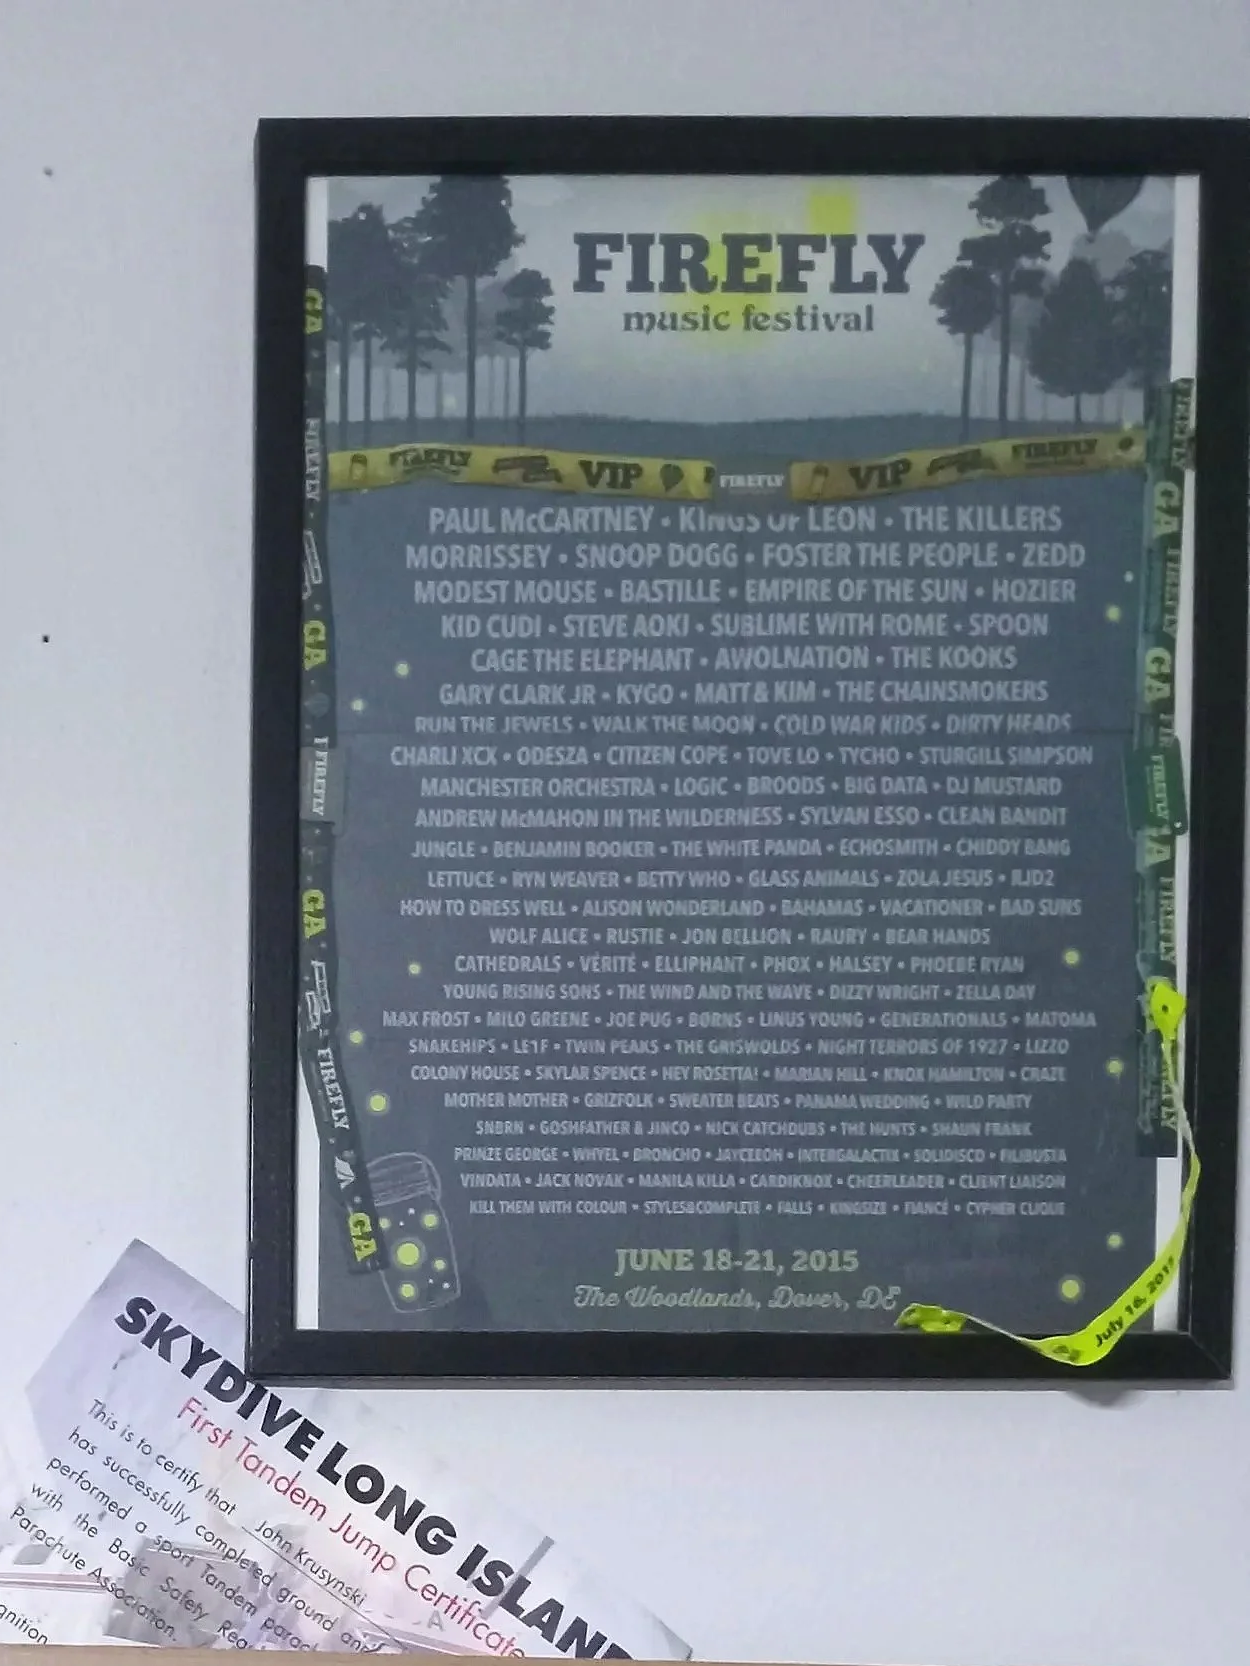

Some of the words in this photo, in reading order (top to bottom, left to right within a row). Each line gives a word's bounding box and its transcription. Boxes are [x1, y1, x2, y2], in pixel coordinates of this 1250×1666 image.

[572, 232, 926, 294] FIREFLY
[622, 305, 731, 334] music
[741, 304, 874, 332] festival
[1011, 438, 1098, 460] FIREFLY
[578, 459, 644, 490] VIP
[849, 458, 911, 491] VIP
[429, 506, 498, 533] PAUL
[501, 506, 654, 533] McCARTNEY
[807, 506, 876, 532] LEON
[900, 506, 950, 532] THE
[956, 505, 1063, 532] KILLERS
[1154, 480, 1180, 539] GA
[405, 543, 551, 569] MORRISSEY
[575, 543, 662, 569] SNOOP
[668, 543, 738, 568] DOGG
[762, 542, 851, 568] FOSTER
[856, 542, 901, 568] THE
[907, 542, 998, 568] PEOPLE
[1021, 542, 1086, 568] ZEDD
[414, 580, 509, 604] MODEST
[514, 580, 597, 604] MOUSE
[621, 579, 721, 603] BASTILLE
[745, 579, 831, 603] EMPIRE
[838, 579, 867, 603] OF
[871, 579, 914, 603] THE
[920, 579, 968, 603] SUN
[992, 579, 1076, 602] HOZIER
[441, 614, 481, 638] KID
[486, 614, 542, 638] CUDI
[563, 614, 628, 638] STEVE
[633, 613, 690, 637] AOKI
[709, 613, 810, 637] SUBLIME
[814, 613, 874, 637] WITH
[880, 612, 949, 637] ROME
[967, 613, 1049, 636] SPOON
[303, 619, 327, 671] GA
[471, 648, 529, 671] CAGE
[532, 648, 574, 671] THE
[580, 647, 694, 671] ELEPHANT
[714, 646, 869, 670] AWOLNATION
[890, 646, 932, 669] THE
[938, 646, 1018, 669] KOOKS
[1145, 647, 1171, 704] GA
[439, 683, 494, 706] GARY
[499, 683, 565, 705] CLARK
[570, 683, 596, 705] JR
[616, 683, 674, 705] KYGO
[694, 682, 753, 703] MATT
[774, 682, 816, 702] KIM
[835, 681, 874, 702] THE
[880, 681, 1049, 702] CHAINSMOKERS
[674, 777, 728, 797] LOGIC
[747, 777, 825, 795] BROODS
[302, 889, 326, 940] GA
[489, 928, 538, 945] WOLF
[541, 928, 589, 945] ALICE
[606, 928, 664, 944] RUSTIE
[454, 956, 561, 973] CATHEDRALS
[829, 956, 892, 973] HALSEY
[317, 1048, 350, 1130] FIREFLY
[349, 1212, 377, 1262] GA
[614, 1248, 695, 1277] JUNE
[702, 1248, 785, 1276] 18-21,
[792, 1249, 860, 1272] 2015
[573, 1284, 620, 1308] The
[624, 1285, 761, 1311] Woodlands,
[768, 1285, 850, 1312] Dover,
[857, 1286, 902, 1311] DE
[1096, 1315, 1124, 1348] July
[114, 1297, 324, 1462] SKYDIVE
[316, 1441, 457, 1556] LONG
[87, 1399, 118, 1432] This
[120, 1425, 135, 1443] is
[137, 1436, 153, 1455] to
[155, 1454, 203, 1493] certify
[204, 1487, 237, 1516] that
[254, 1520, 293, 1554] John
[293, 1547, 368, 1606] Krusynski
[46, 1456, 133, 1521] performed
[135, 1519, 148, 1534] a
[153, 1533, 195, 1568] sport
[200, 1564, 260, 1617] Tandem
[68, 1426, 97, 1456] has
[103, 1455, 191, 1526] successfully
[195, 1524, 277, 1587] completed
[276, 1587, 338, 1632] ground
[177, 1397, 233, 1449] First
[235, 1436, 328, 1522] Tandem
[329, 1513, 397, 1573] Jump
[405, 1565, 526, 1658] Certificate
[31, 1483, 64, 1512] with
[74, 1513, 98, 1538] the
[109, 1537, 150, 1577] Basic
[159, 1576, 209, 1622] Safety
[10, 1504, 87, 1570] Parachute
[88, 1567, 177, 1642] Association.
